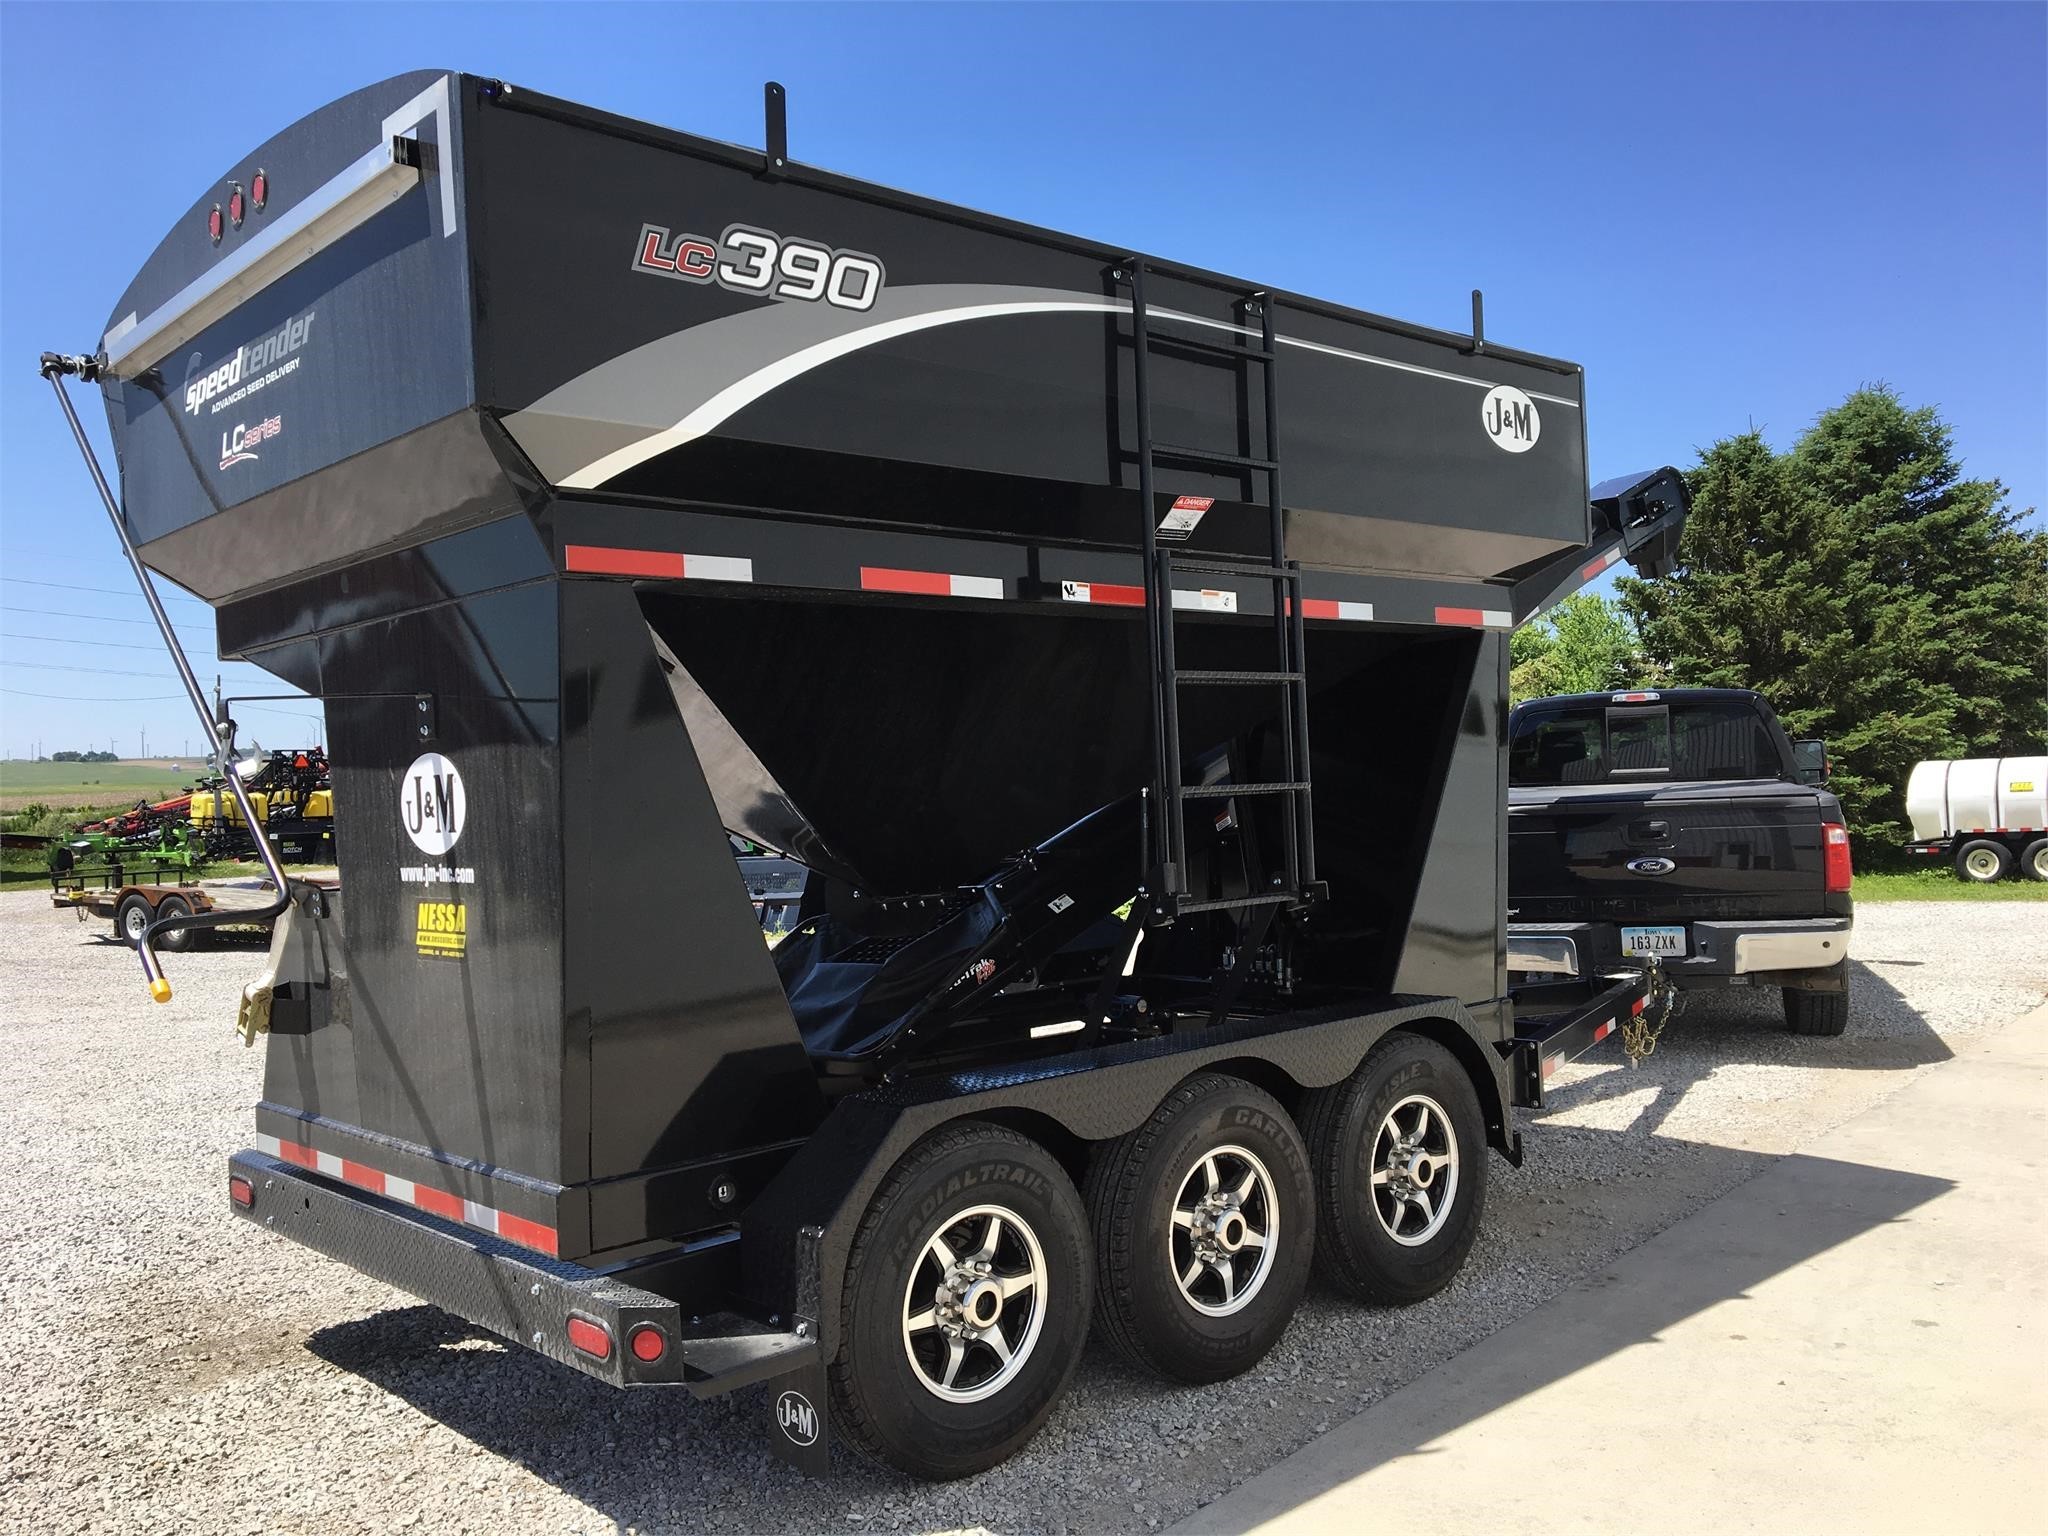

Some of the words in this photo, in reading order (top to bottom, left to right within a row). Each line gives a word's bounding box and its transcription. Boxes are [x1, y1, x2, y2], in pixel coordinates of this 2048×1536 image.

[211, 388, 246, 414] ADVANCED
[247, 376, 265, 395] SEED
[266, 357, 300, 385] DELIVERY
[1486, 396, 1533, 442] J&M
[1184, 498, 1211, 507] DANGER
[406, 773, 457, 835] J&M
[400, 863, 475, 887] www.jm-inc.com
[418, 903, 466, 932] NESSA
[1631, 936, 1651, 950] 163
[1655, 936, 1676, 950] ZXK
[779, 1398, 813, 1438] J&M
